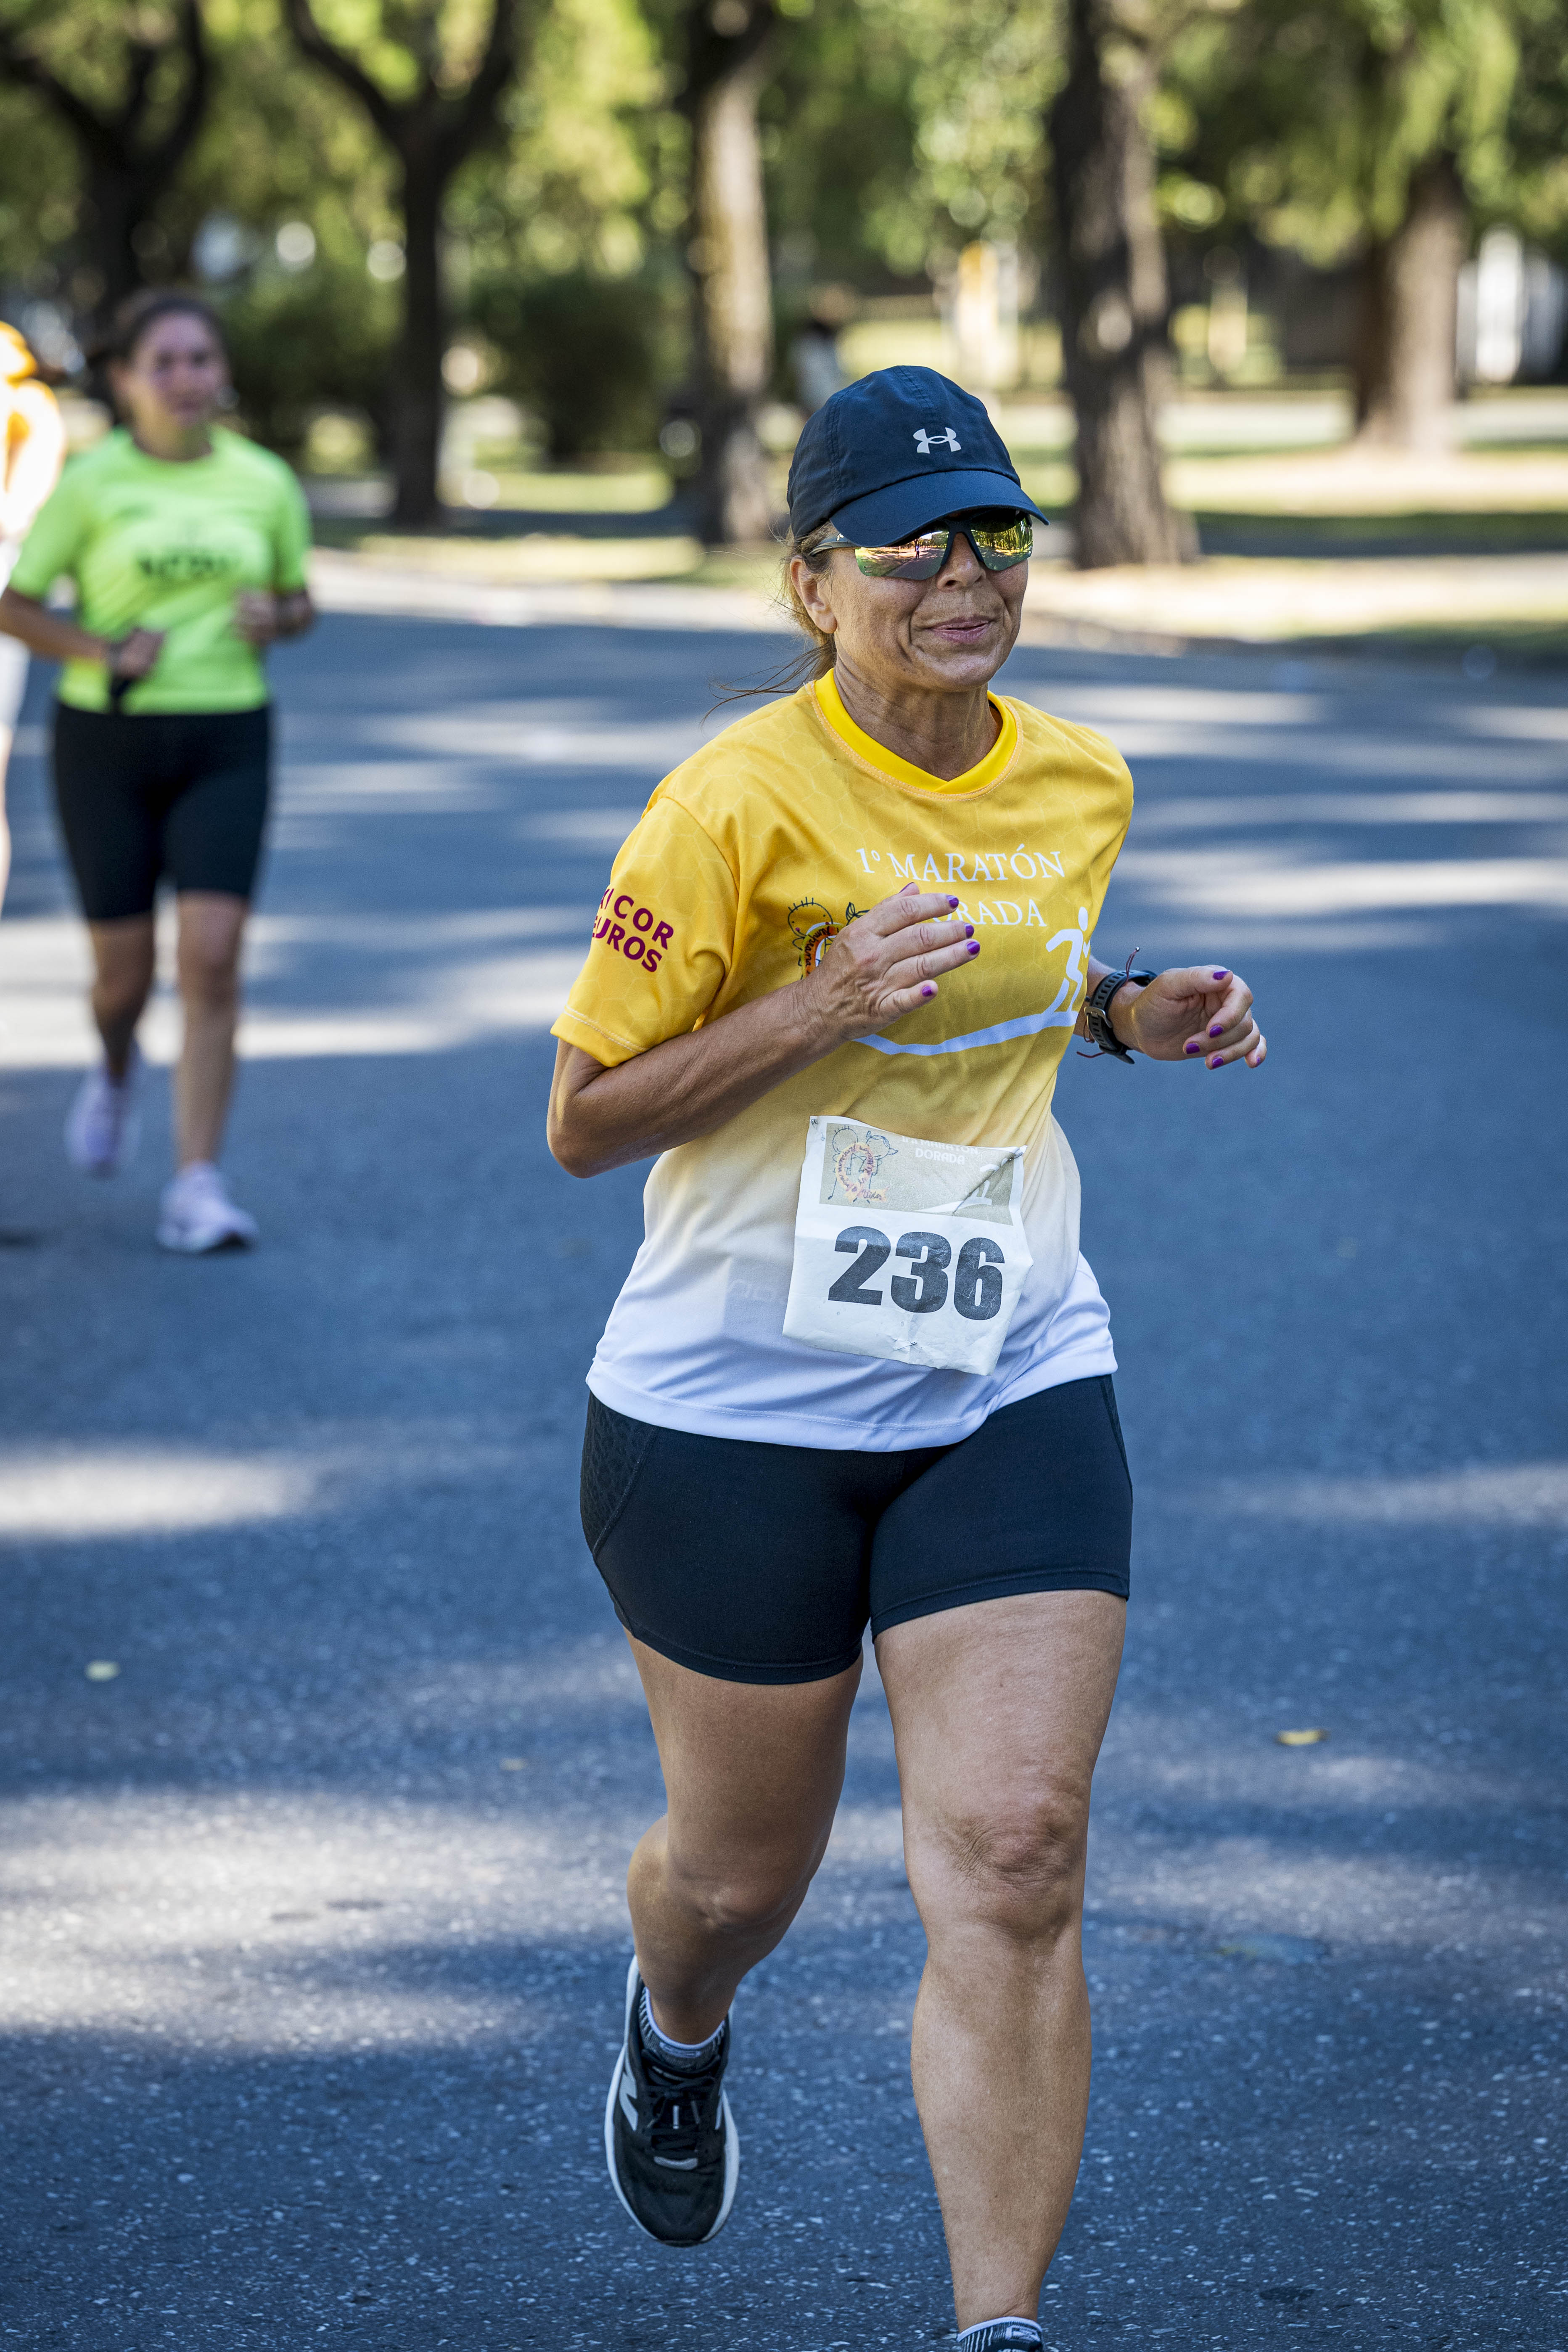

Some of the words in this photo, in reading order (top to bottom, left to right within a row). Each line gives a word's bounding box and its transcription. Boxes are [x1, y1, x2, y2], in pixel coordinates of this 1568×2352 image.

[886, 843, 1066, 883] MARATÓN
[933, 899, 1047, 927] RADA
[592, 915, 663, 973] UROS
[915, 1147, 965, 1165] DORADA
[828, 1225, 1005, 1320] 236
